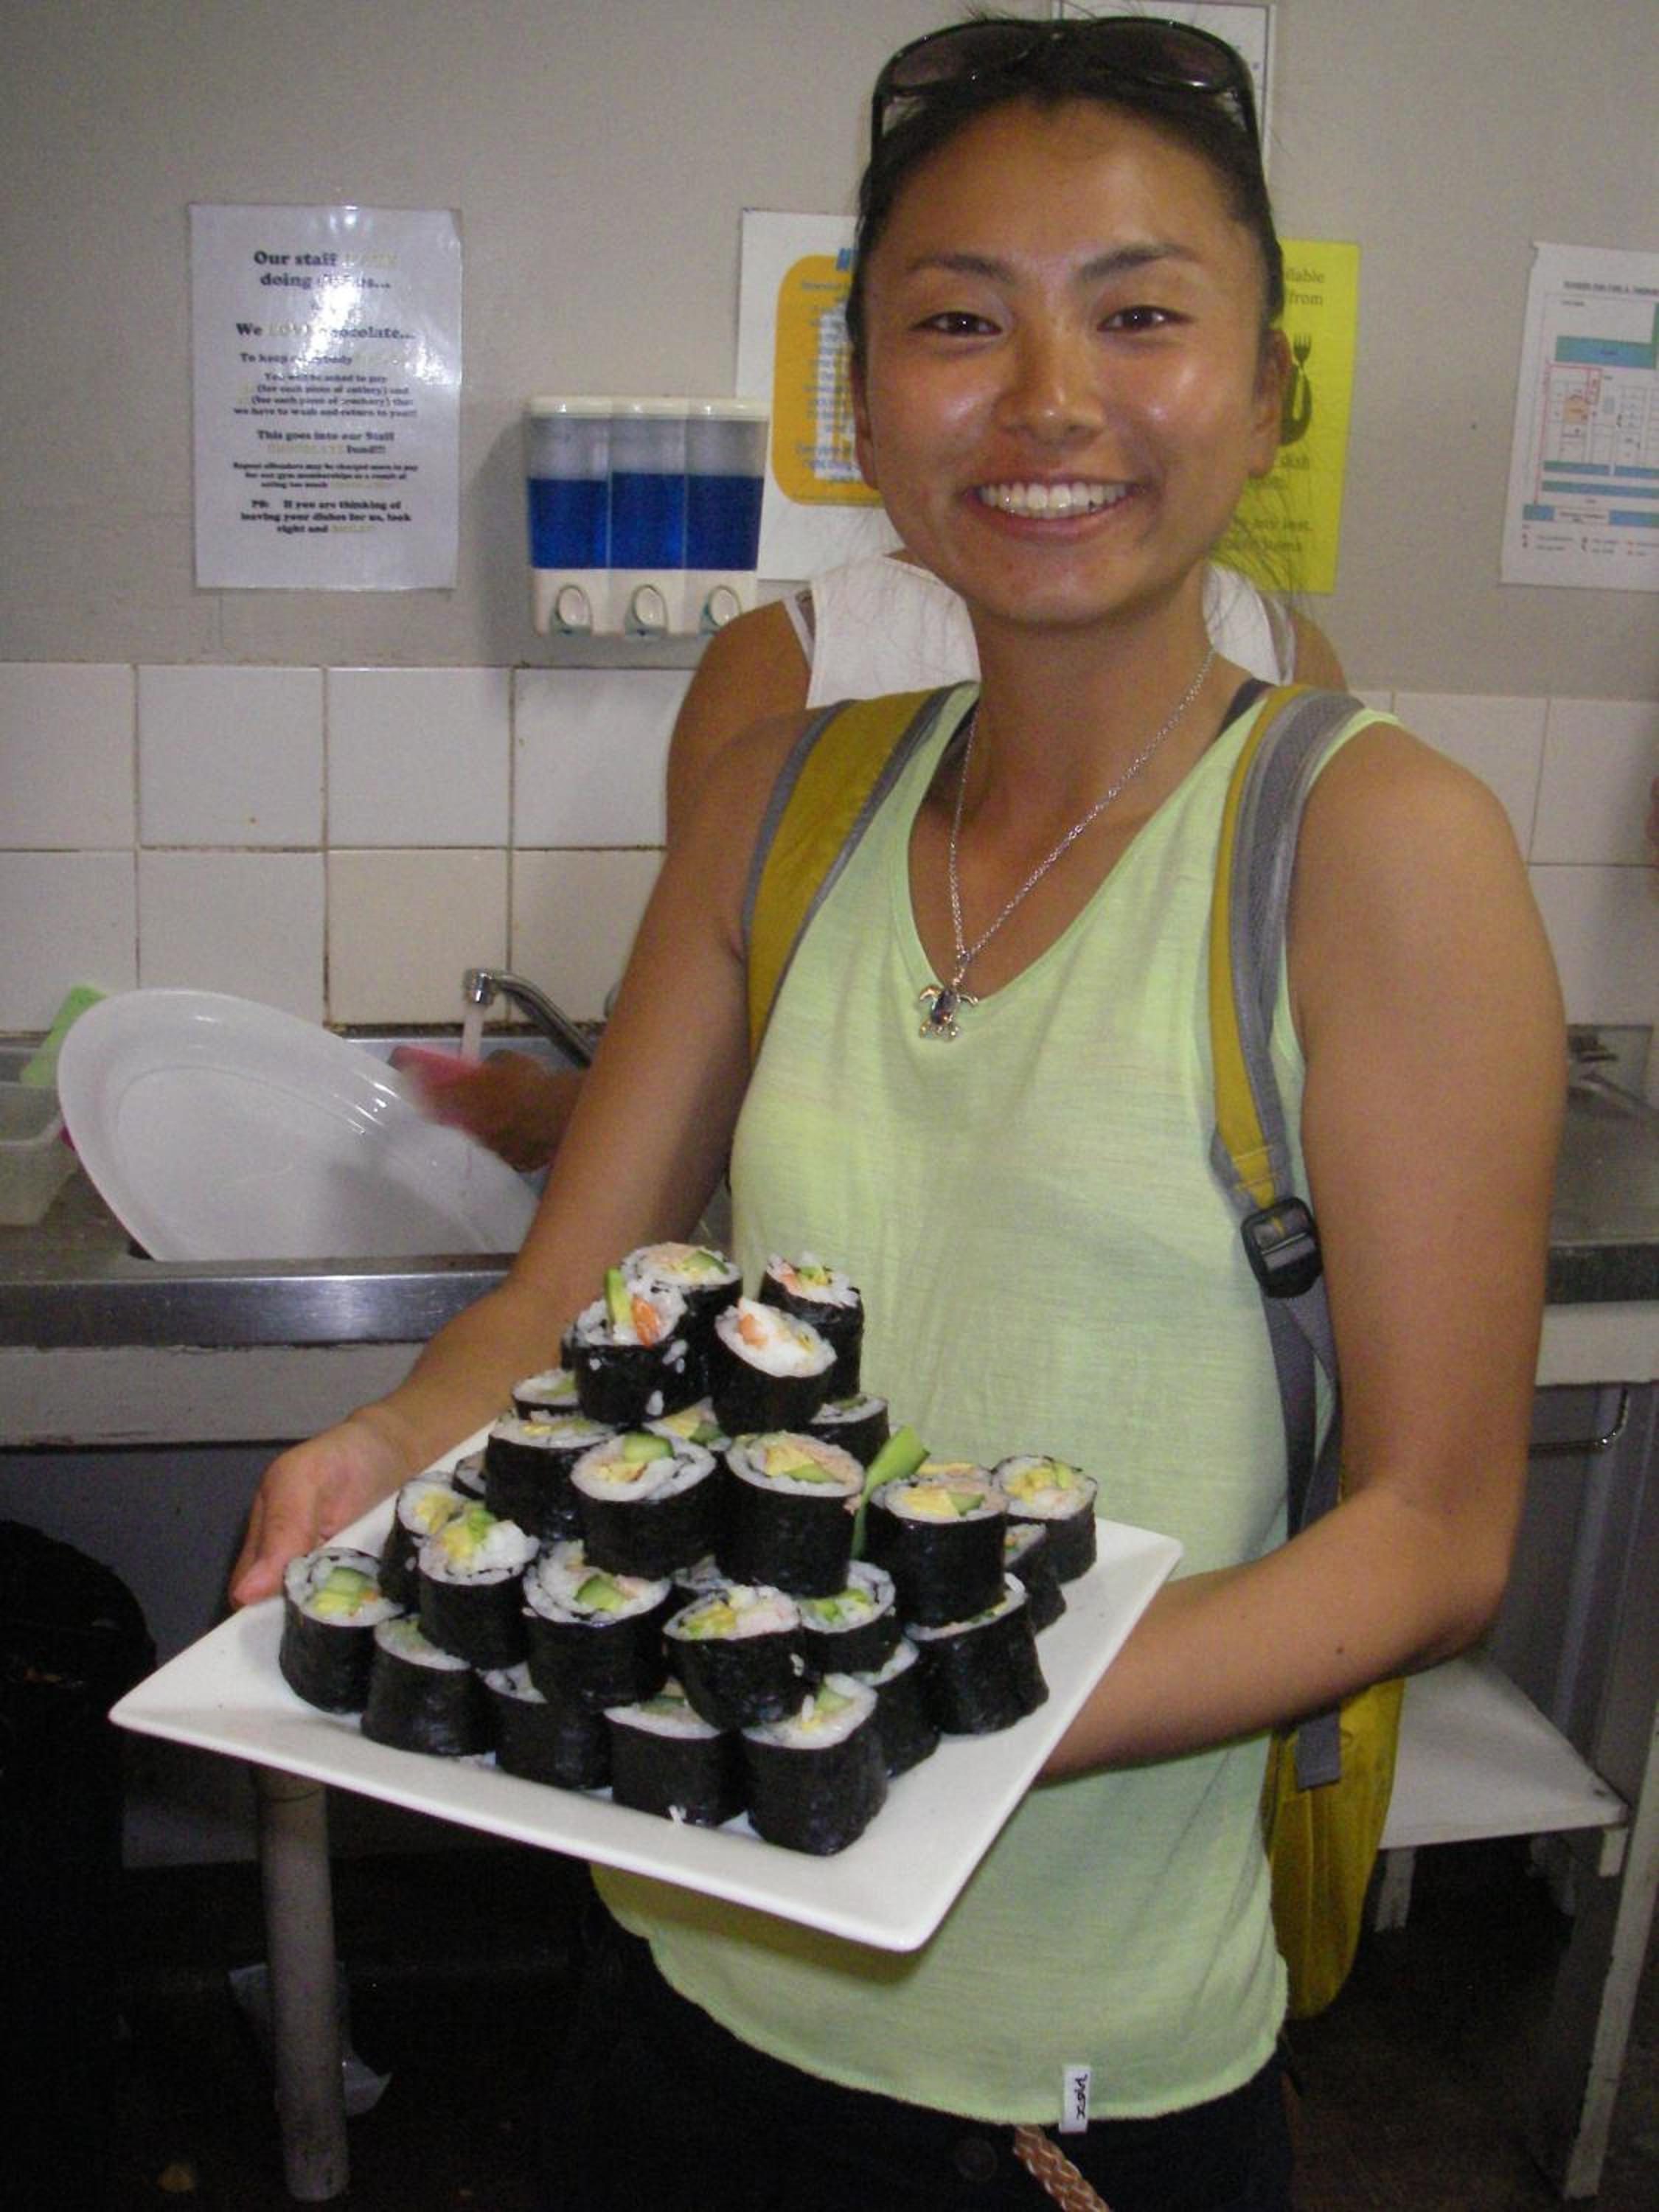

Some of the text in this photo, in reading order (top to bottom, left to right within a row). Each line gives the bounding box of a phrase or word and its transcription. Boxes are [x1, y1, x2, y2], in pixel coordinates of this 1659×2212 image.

[254, 250, 291, 265] Our
[295, 252, 338, 266] staff
[260, 272, 312, 289] doing
[236, 322, 262, 335] We
[260, 353, 288, 364] keep
[257, 430, 282, 440] This
[286, 431, 311, 442] goes
[314, 431, 338, 440] into
[339, 501, 387, 510] thinking
[308, 525, 328, 533] and
